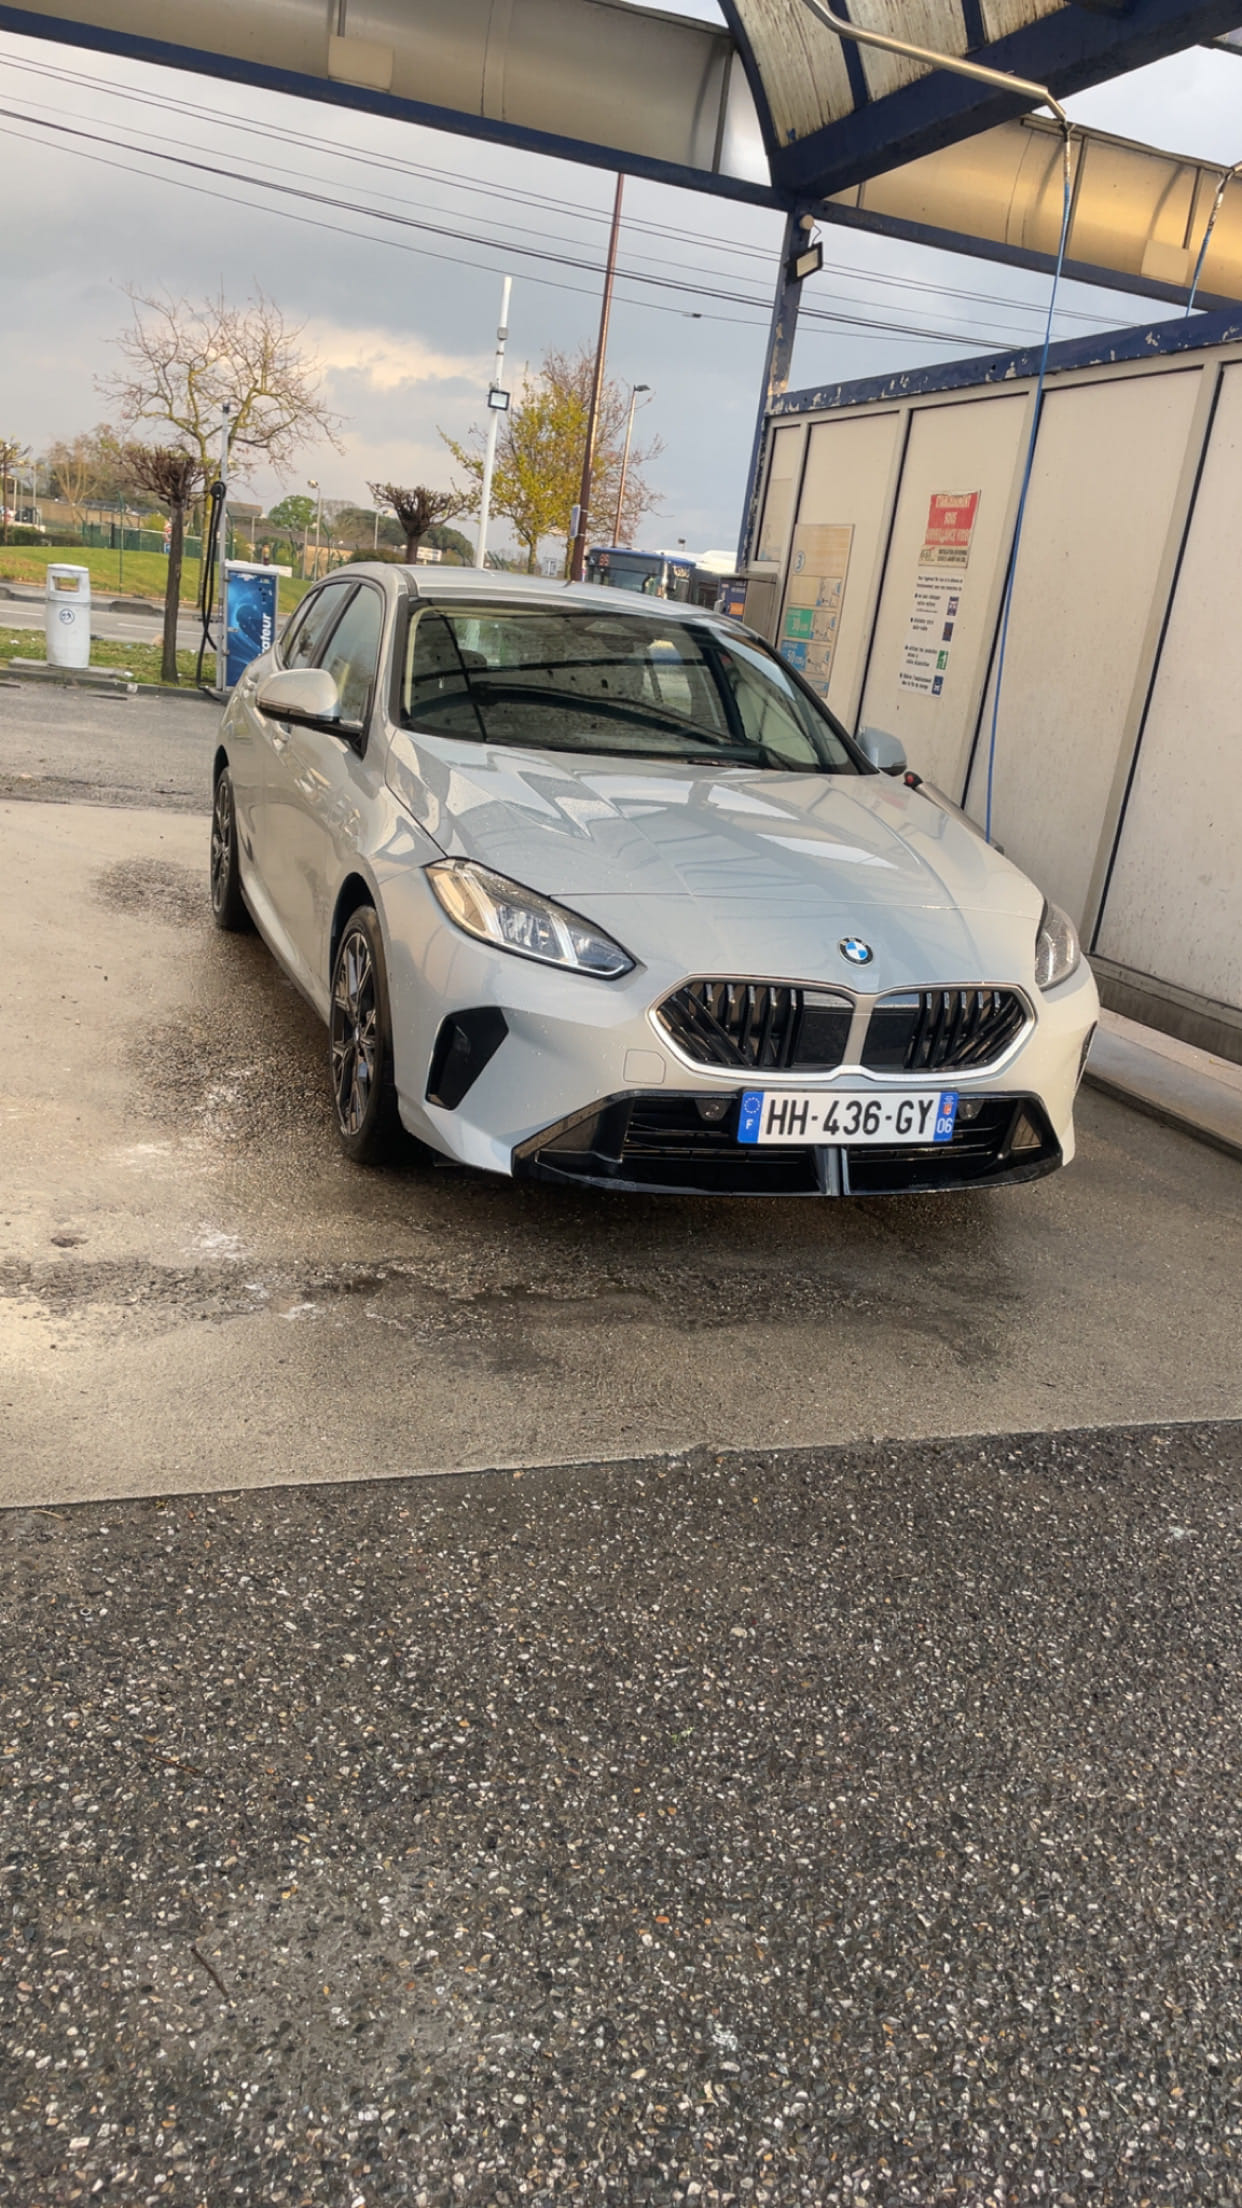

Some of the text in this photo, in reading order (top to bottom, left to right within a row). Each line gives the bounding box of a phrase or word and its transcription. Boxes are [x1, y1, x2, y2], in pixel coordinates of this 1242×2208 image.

[745, 1119, 754, 1130] F
[766, 1099, 934, 1136] HH-436-GY
[936, 1118, 953, 1134] 06
